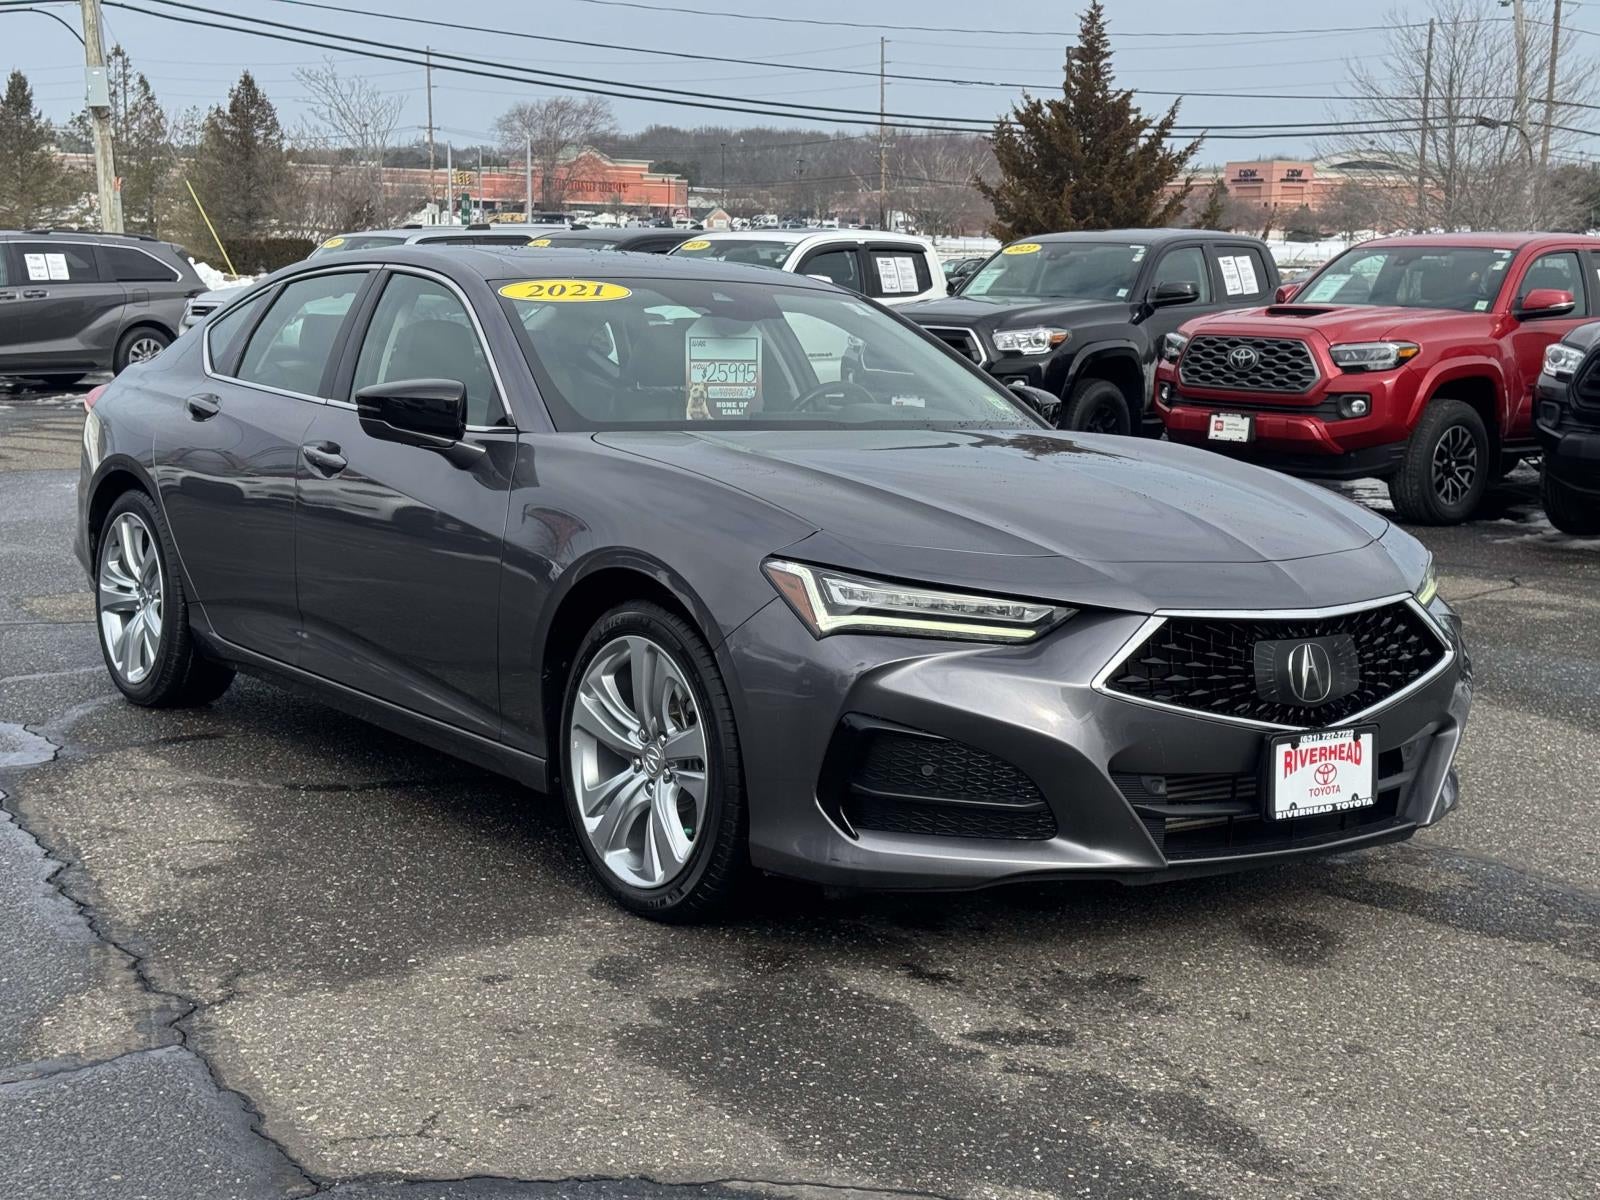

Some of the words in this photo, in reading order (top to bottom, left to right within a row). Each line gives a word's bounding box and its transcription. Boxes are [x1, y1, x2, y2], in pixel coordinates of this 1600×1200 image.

[526, 284, 604, 297] 2021
[1283, 740, 1363, 779] RIVERHEAD
[1309, 784, 1341, 798] TOYOTA
[1275, 804, 1334, 820] RIVERHEAD
[1335, 797, 1374, 810] TOYOTA
